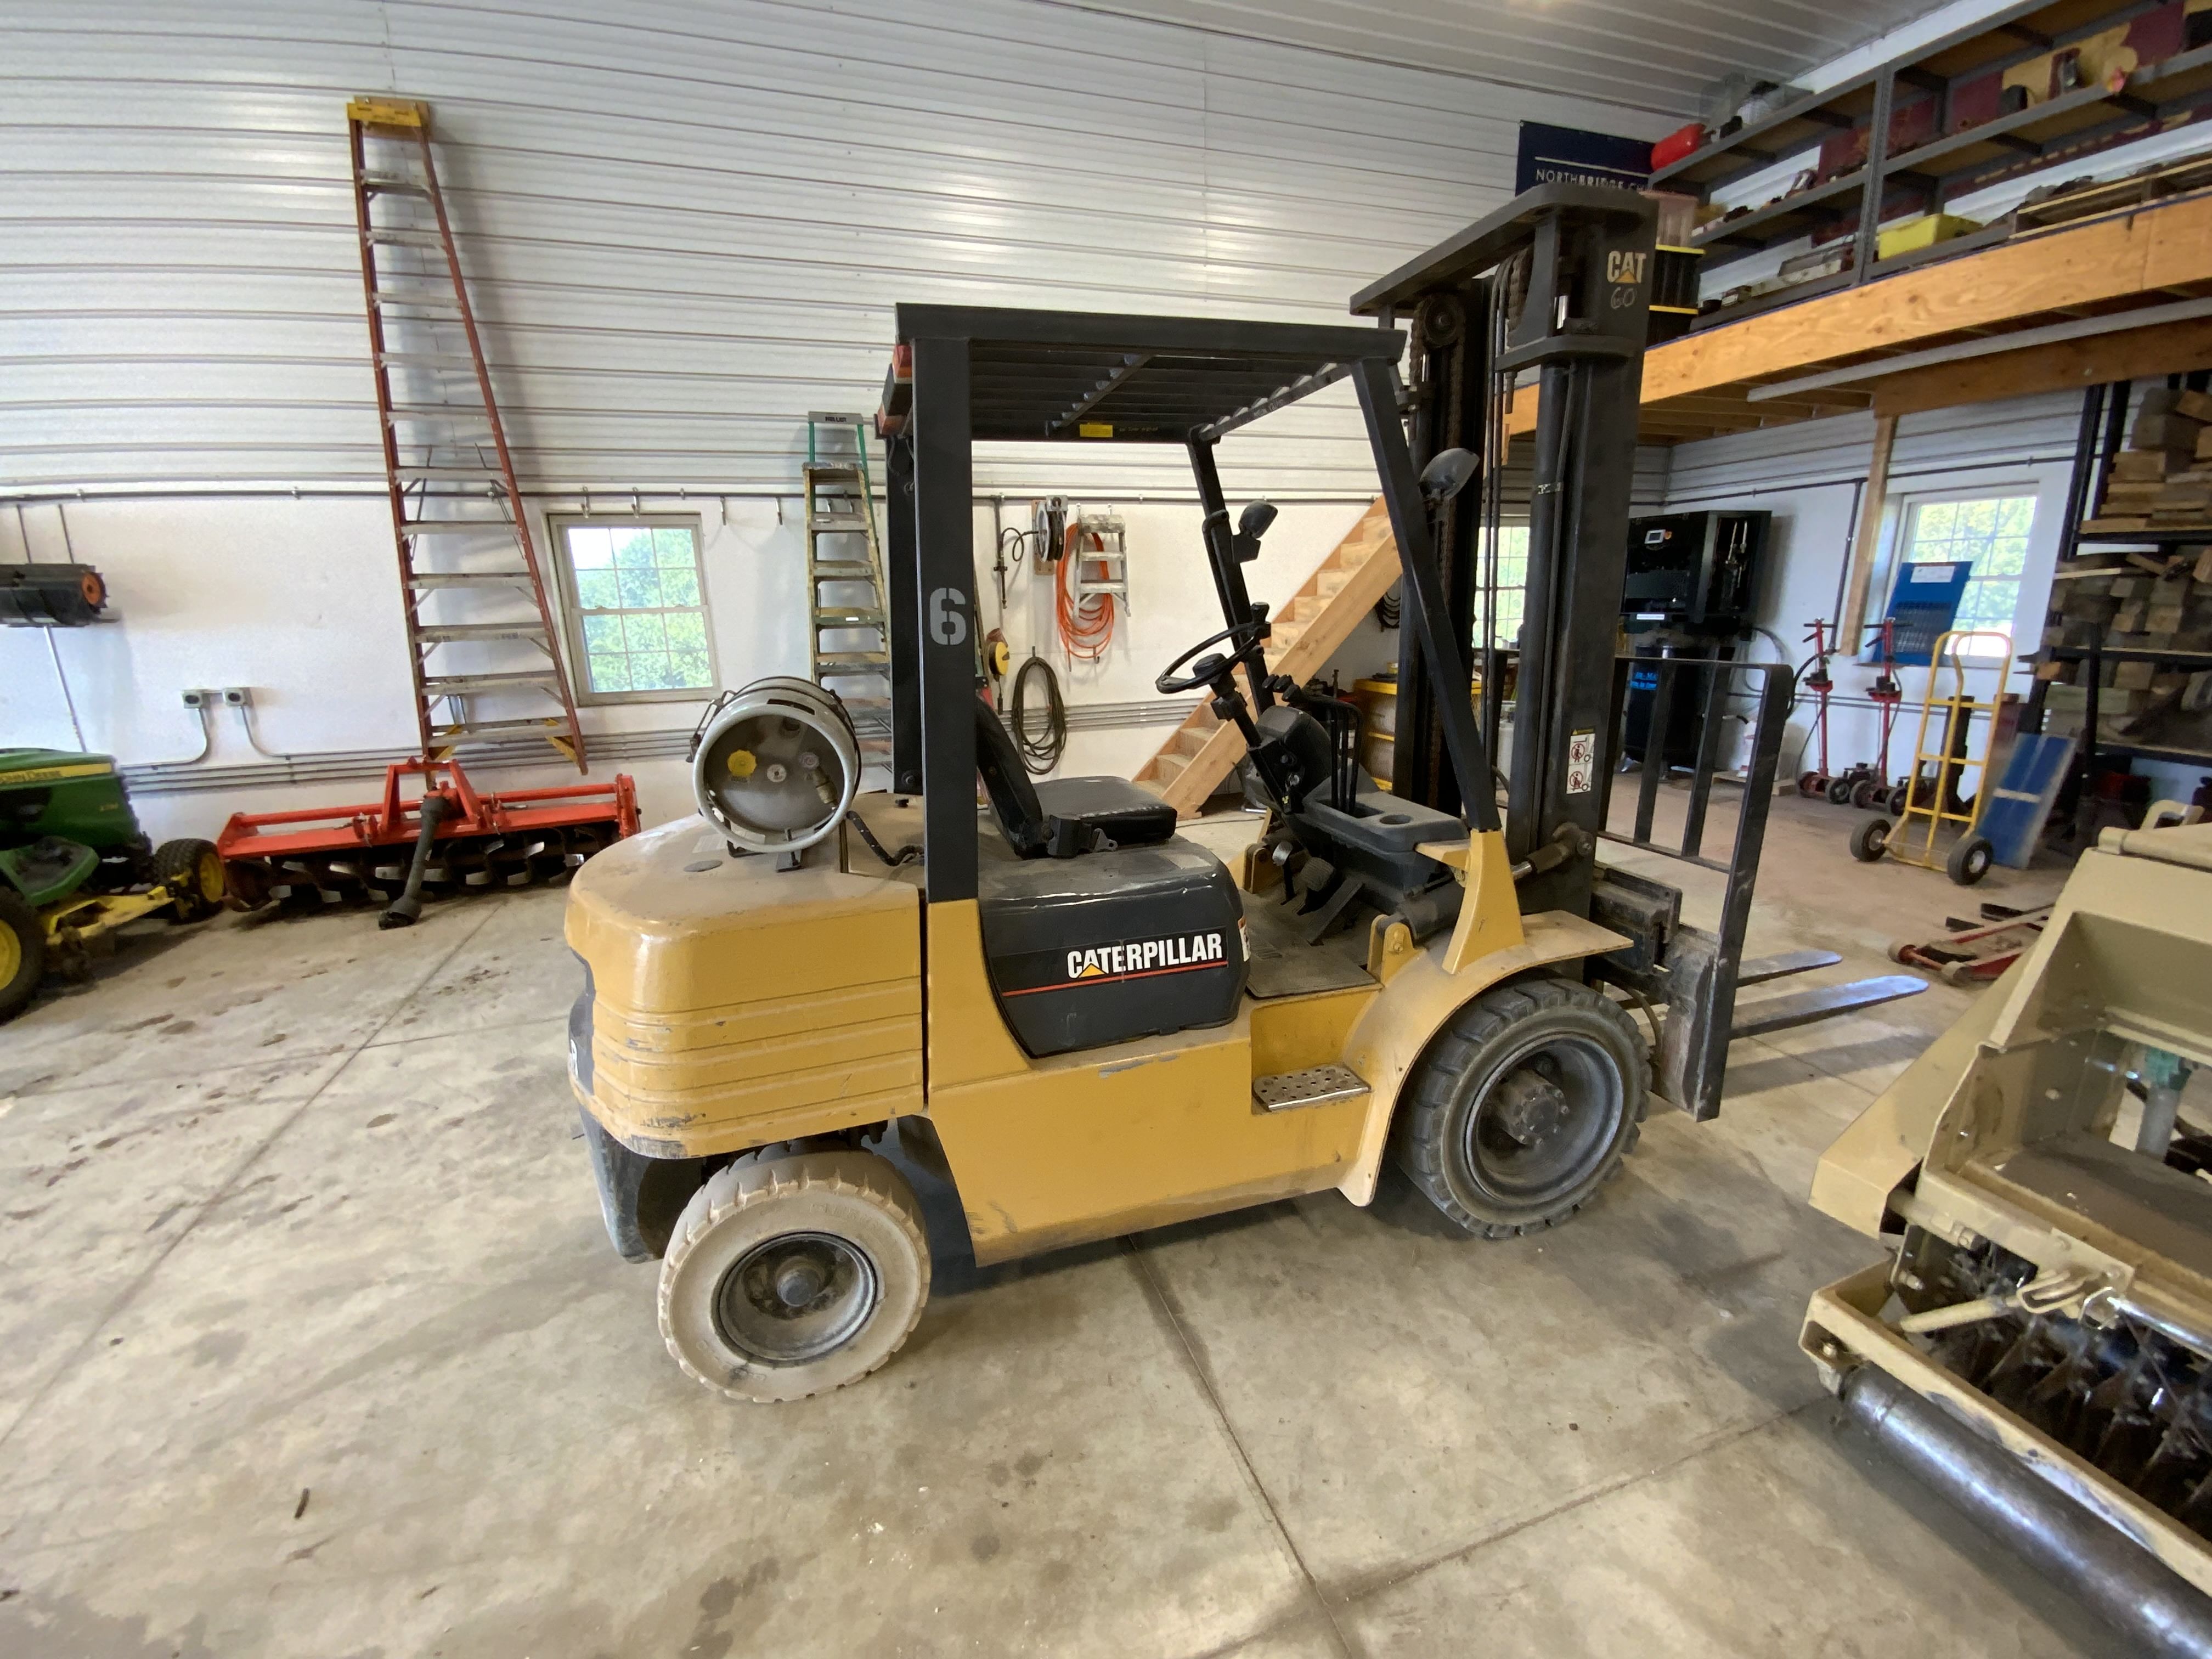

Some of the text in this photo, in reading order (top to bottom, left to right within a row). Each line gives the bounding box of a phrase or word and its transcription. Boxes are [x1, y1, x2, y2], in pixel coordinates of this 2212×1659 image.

[1607, 251, 1646, 283] CAT
[929, 587, 966, 645] 6
[1067, 933, 1223, 979] CATERPILLAR
